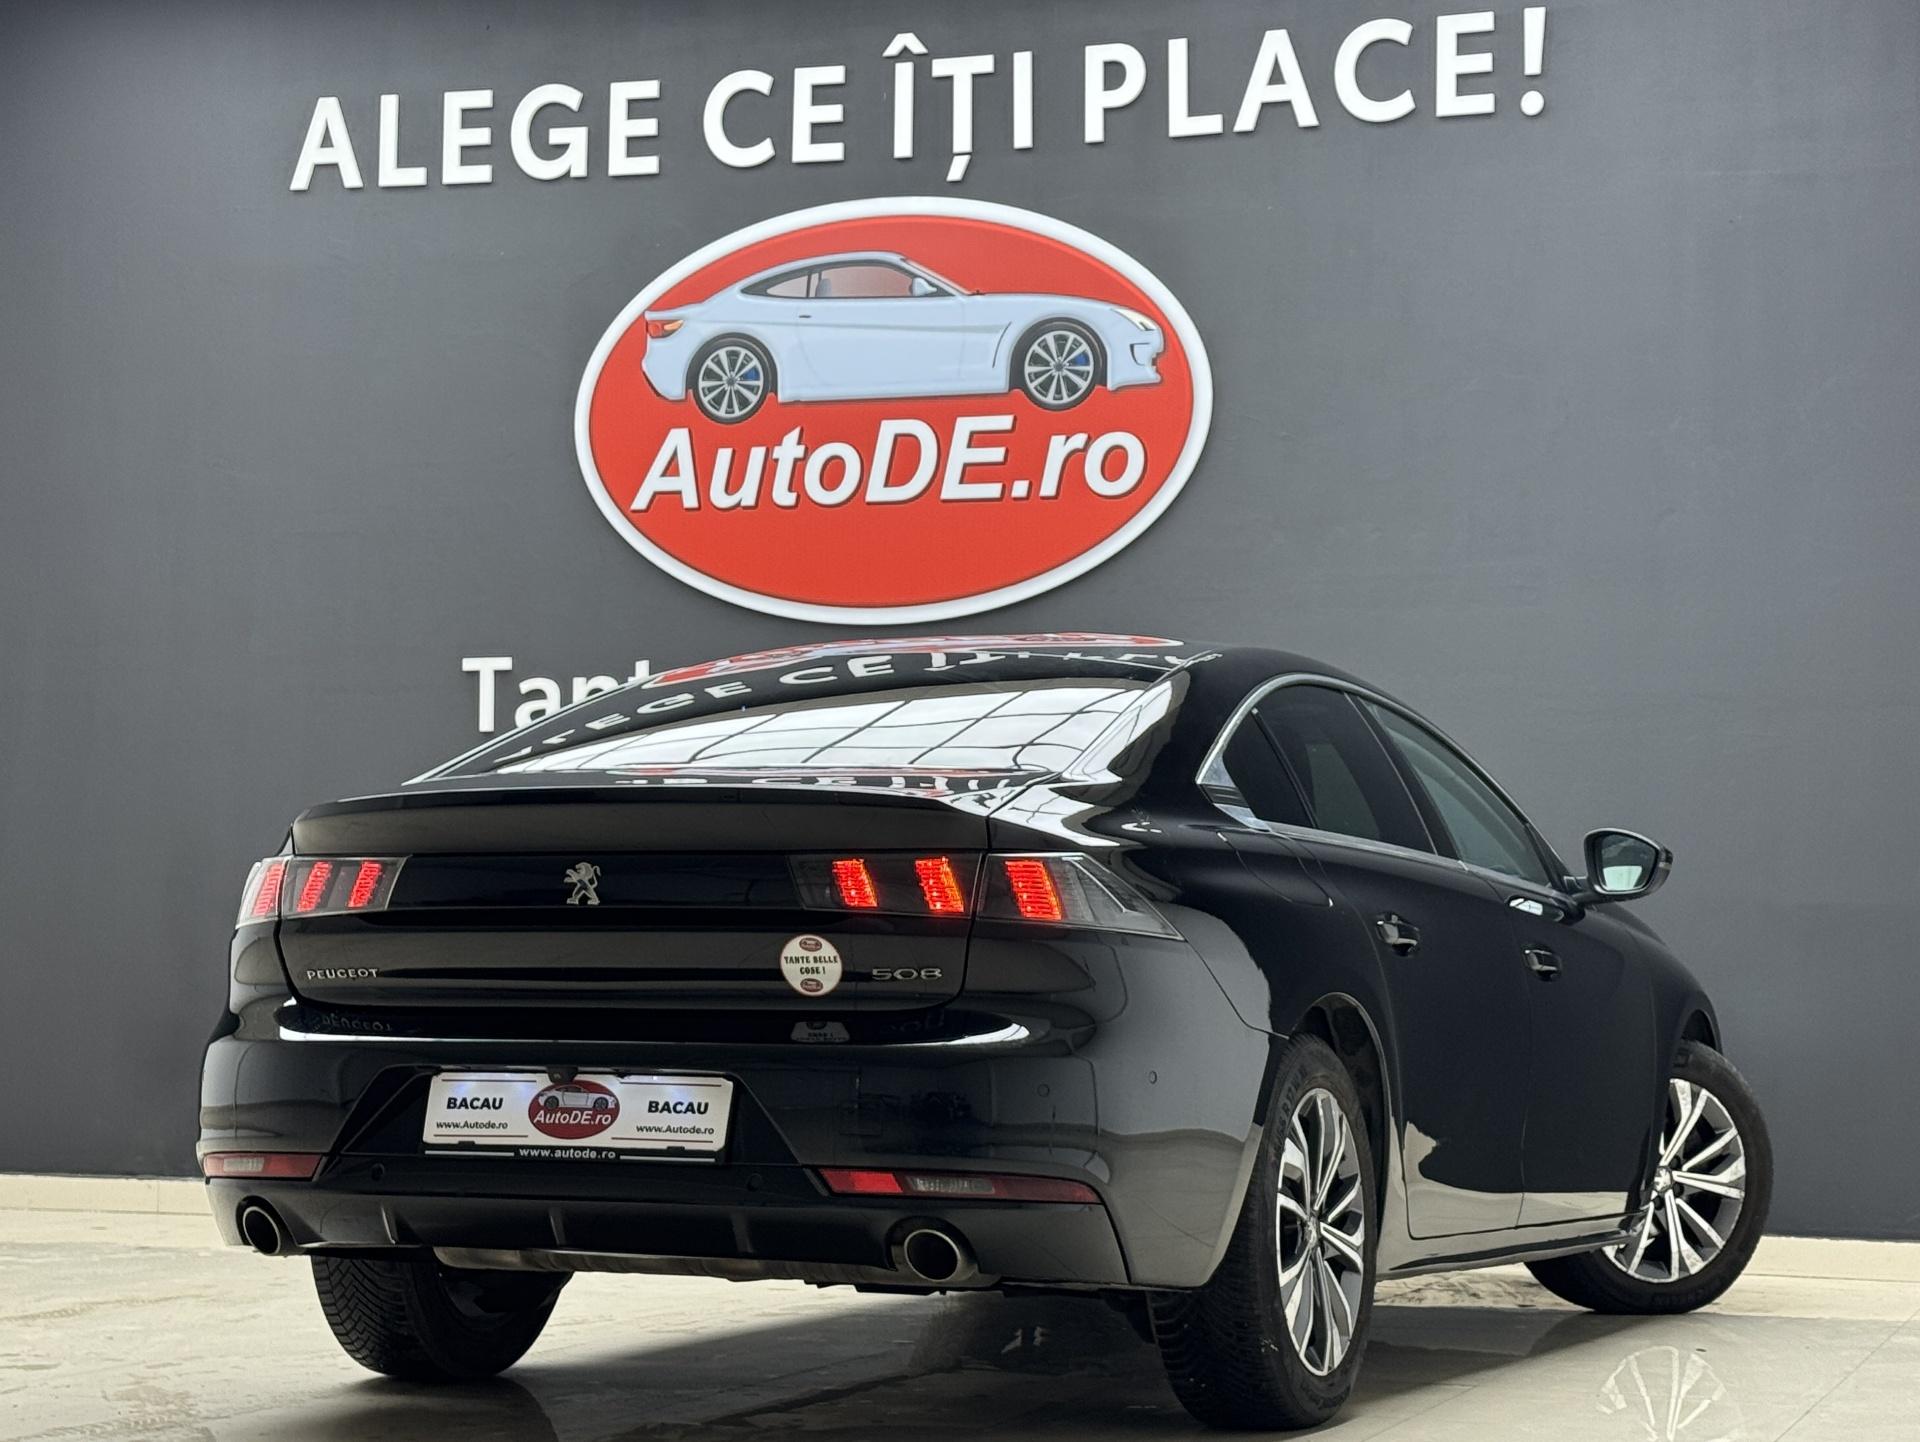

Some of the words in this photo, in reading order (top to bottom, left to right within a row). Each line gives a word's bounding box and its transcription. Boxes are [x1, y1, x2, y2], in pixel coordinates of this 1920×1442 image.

[289, 79, 661, 191] ALEGE
[703, 65, 846, 168] CE
[882, 32, 1034, 182] ÎȚI
[1084, 6, 1548, 143] PLACE!
[630, 414, 1147, 512] AutoDE.ro
[461, 656, 650, 733] Ta
[784, 955, 811, 965] TANTE
[813, 955, 838, 964] BELLE
[306, 968, 378, 980] PEUGEOT
[799, 966, 821, 975] COSE
[872, 968, 943, 980] 508
[447, 1097, 503, 1109] BACAU
[647, 1100, 709, 1114] BACAU
[533, 1109, 612, 1126] AutoDE.ro
[436, 1120, 508, 1130] www.Autode.ro
[636, 1123, 714, 1135] www.Autode.ro
[519, 1147, 616, 1159] www.autode.ro
